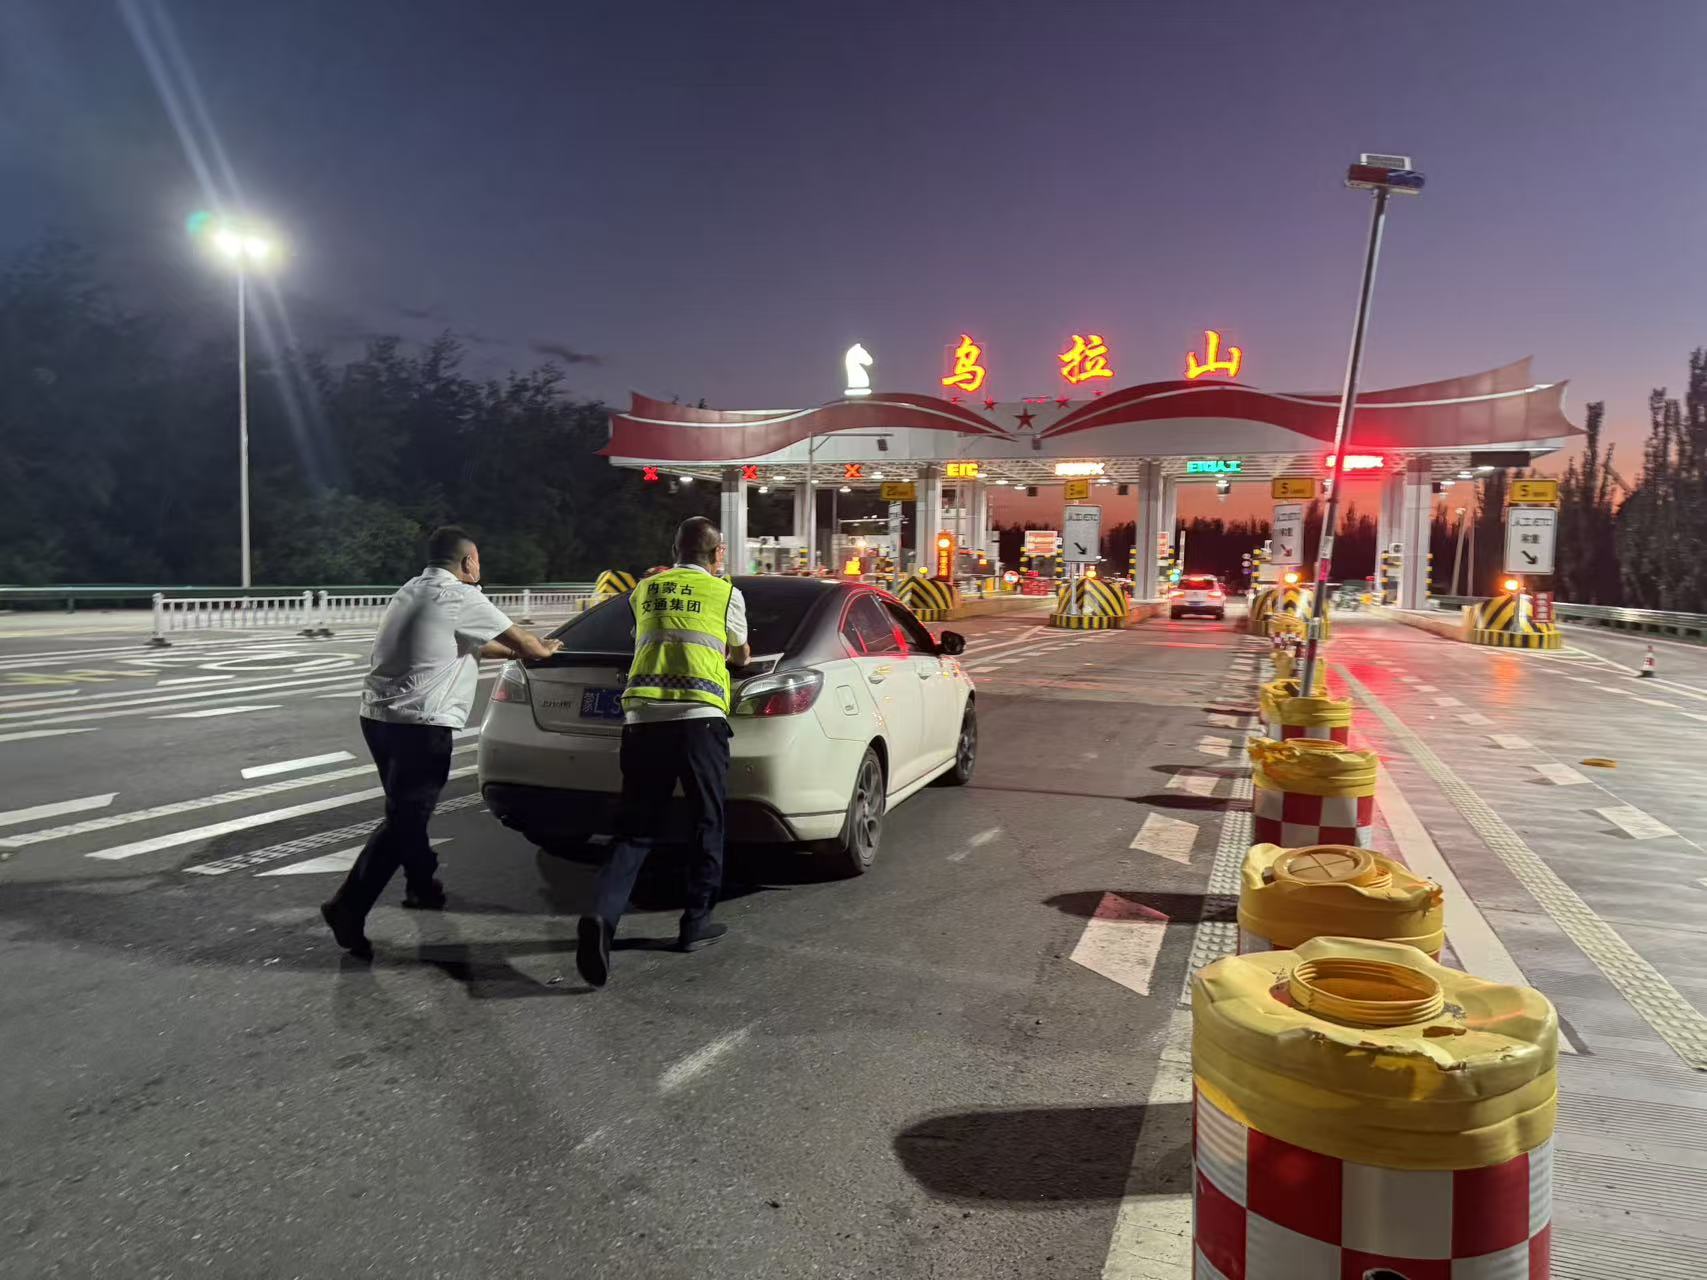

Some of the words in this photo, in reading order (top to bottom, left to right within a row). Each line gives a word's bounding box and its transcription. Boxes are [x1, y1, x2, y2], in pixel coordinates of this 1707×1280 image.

[941, 330, 1243, 391] 乌拉山
[647, 582, 696, 596] 内蒙古
[641, 597, 702, 615] 交通集团
